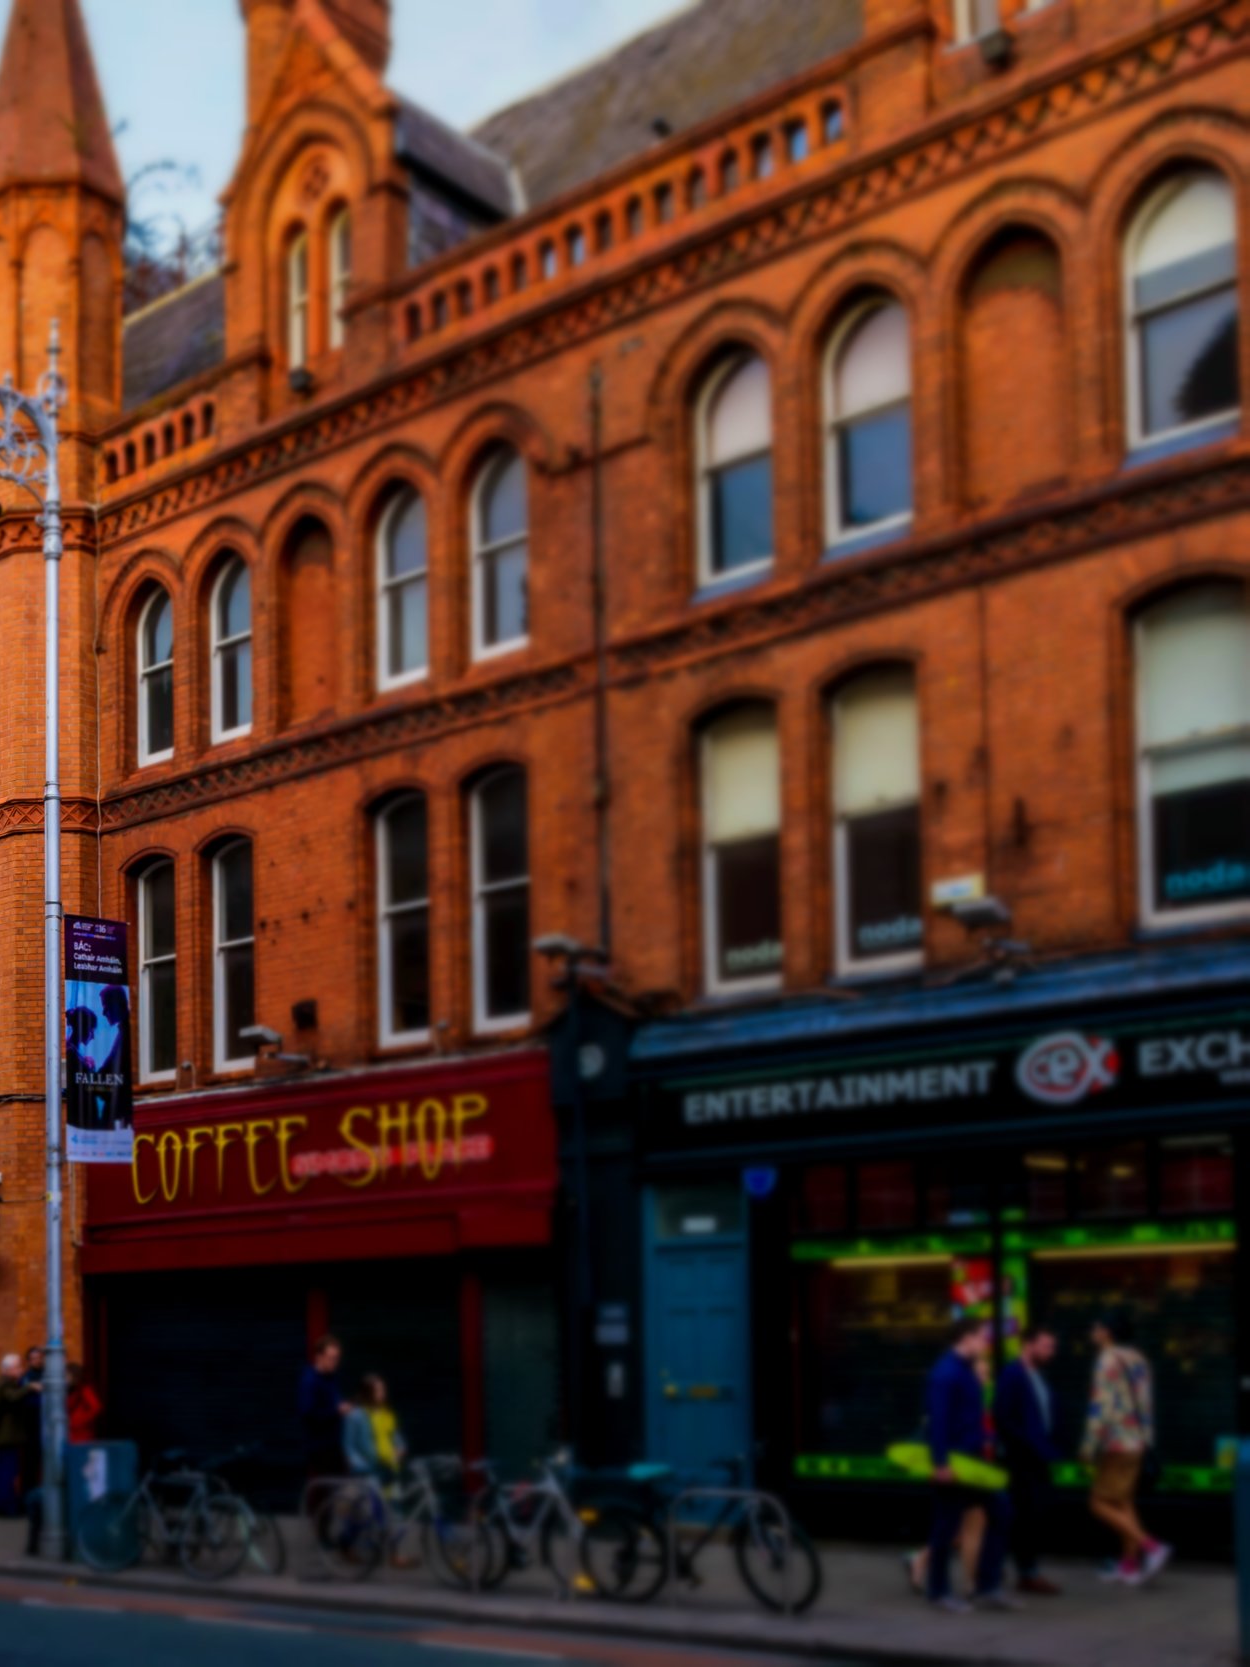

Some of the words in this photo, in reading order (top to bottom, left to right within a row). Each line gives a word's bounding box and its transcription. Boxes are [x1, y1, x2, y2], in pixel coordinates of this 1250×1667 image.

[73, 940, 92, 952] BÁC:
[74, 1072, 125, 1086] FALLEN
[682, 1060, 997, 1124] ENTERTAINMENT
[132, 1115, 309, 1204] COFFEE
[337, 1092, 489, 1187] SHOP
